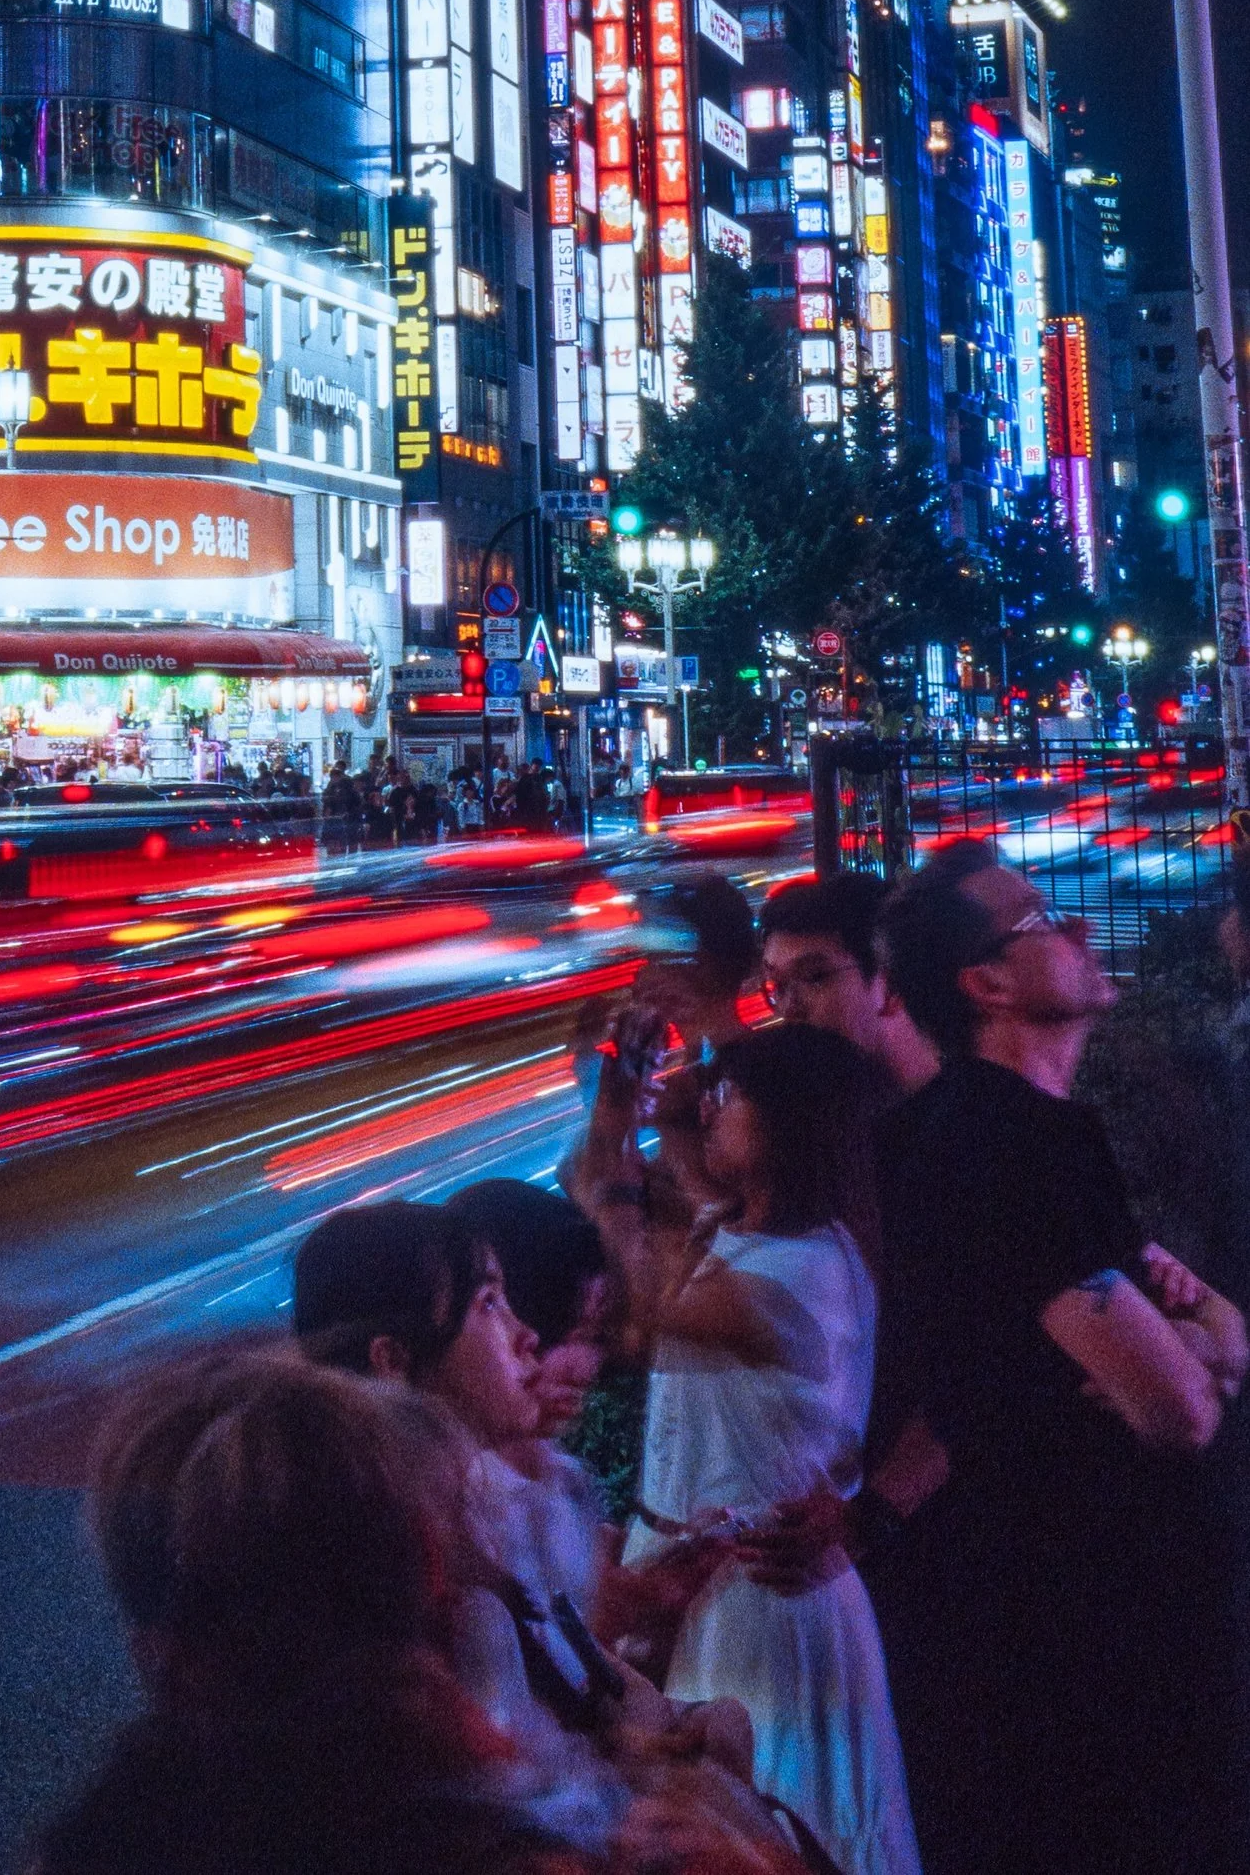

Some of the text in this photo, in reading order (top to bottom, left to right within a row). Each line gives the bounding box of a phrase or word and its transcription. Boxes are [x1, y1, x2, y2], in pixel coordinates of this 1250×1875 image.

[660, 67, 683, 183] PARTY
[559, 234, 573, 278] ZEST
[607, 270, 635, 442] パセラ
[291, 368, 357, 415] Don Quijote
[65, 503, 181, 565] Shop
[191, 513, 250, 560] 免税店
[54, 653, 178, 673] Don Quijote
